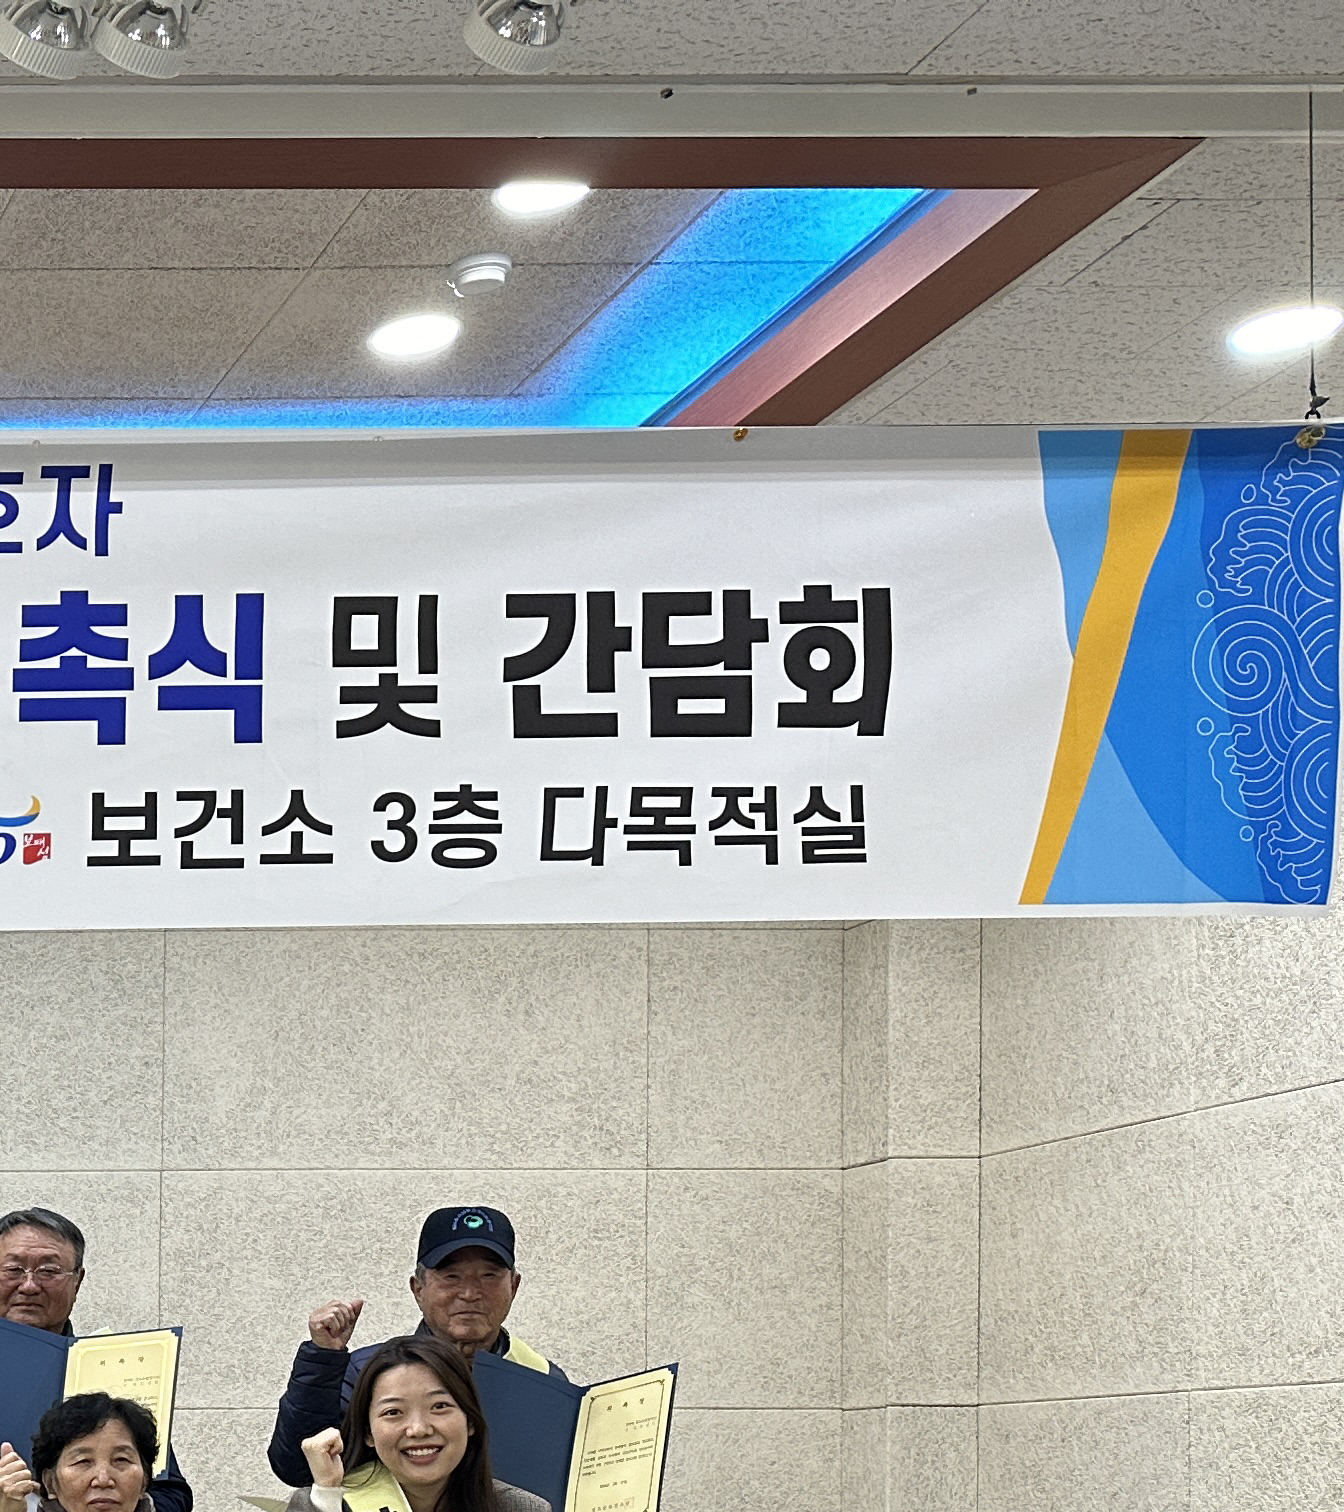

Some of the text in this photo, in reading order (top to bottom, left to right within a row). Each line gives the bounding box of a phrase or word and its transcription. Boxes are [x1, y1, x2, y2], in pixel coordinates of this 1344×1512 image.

[333, 595, 441, 739] 및
[503, 585, 892, 738] 간담회
[87, 784, 867, 869] 보건소 3층 다목적실
